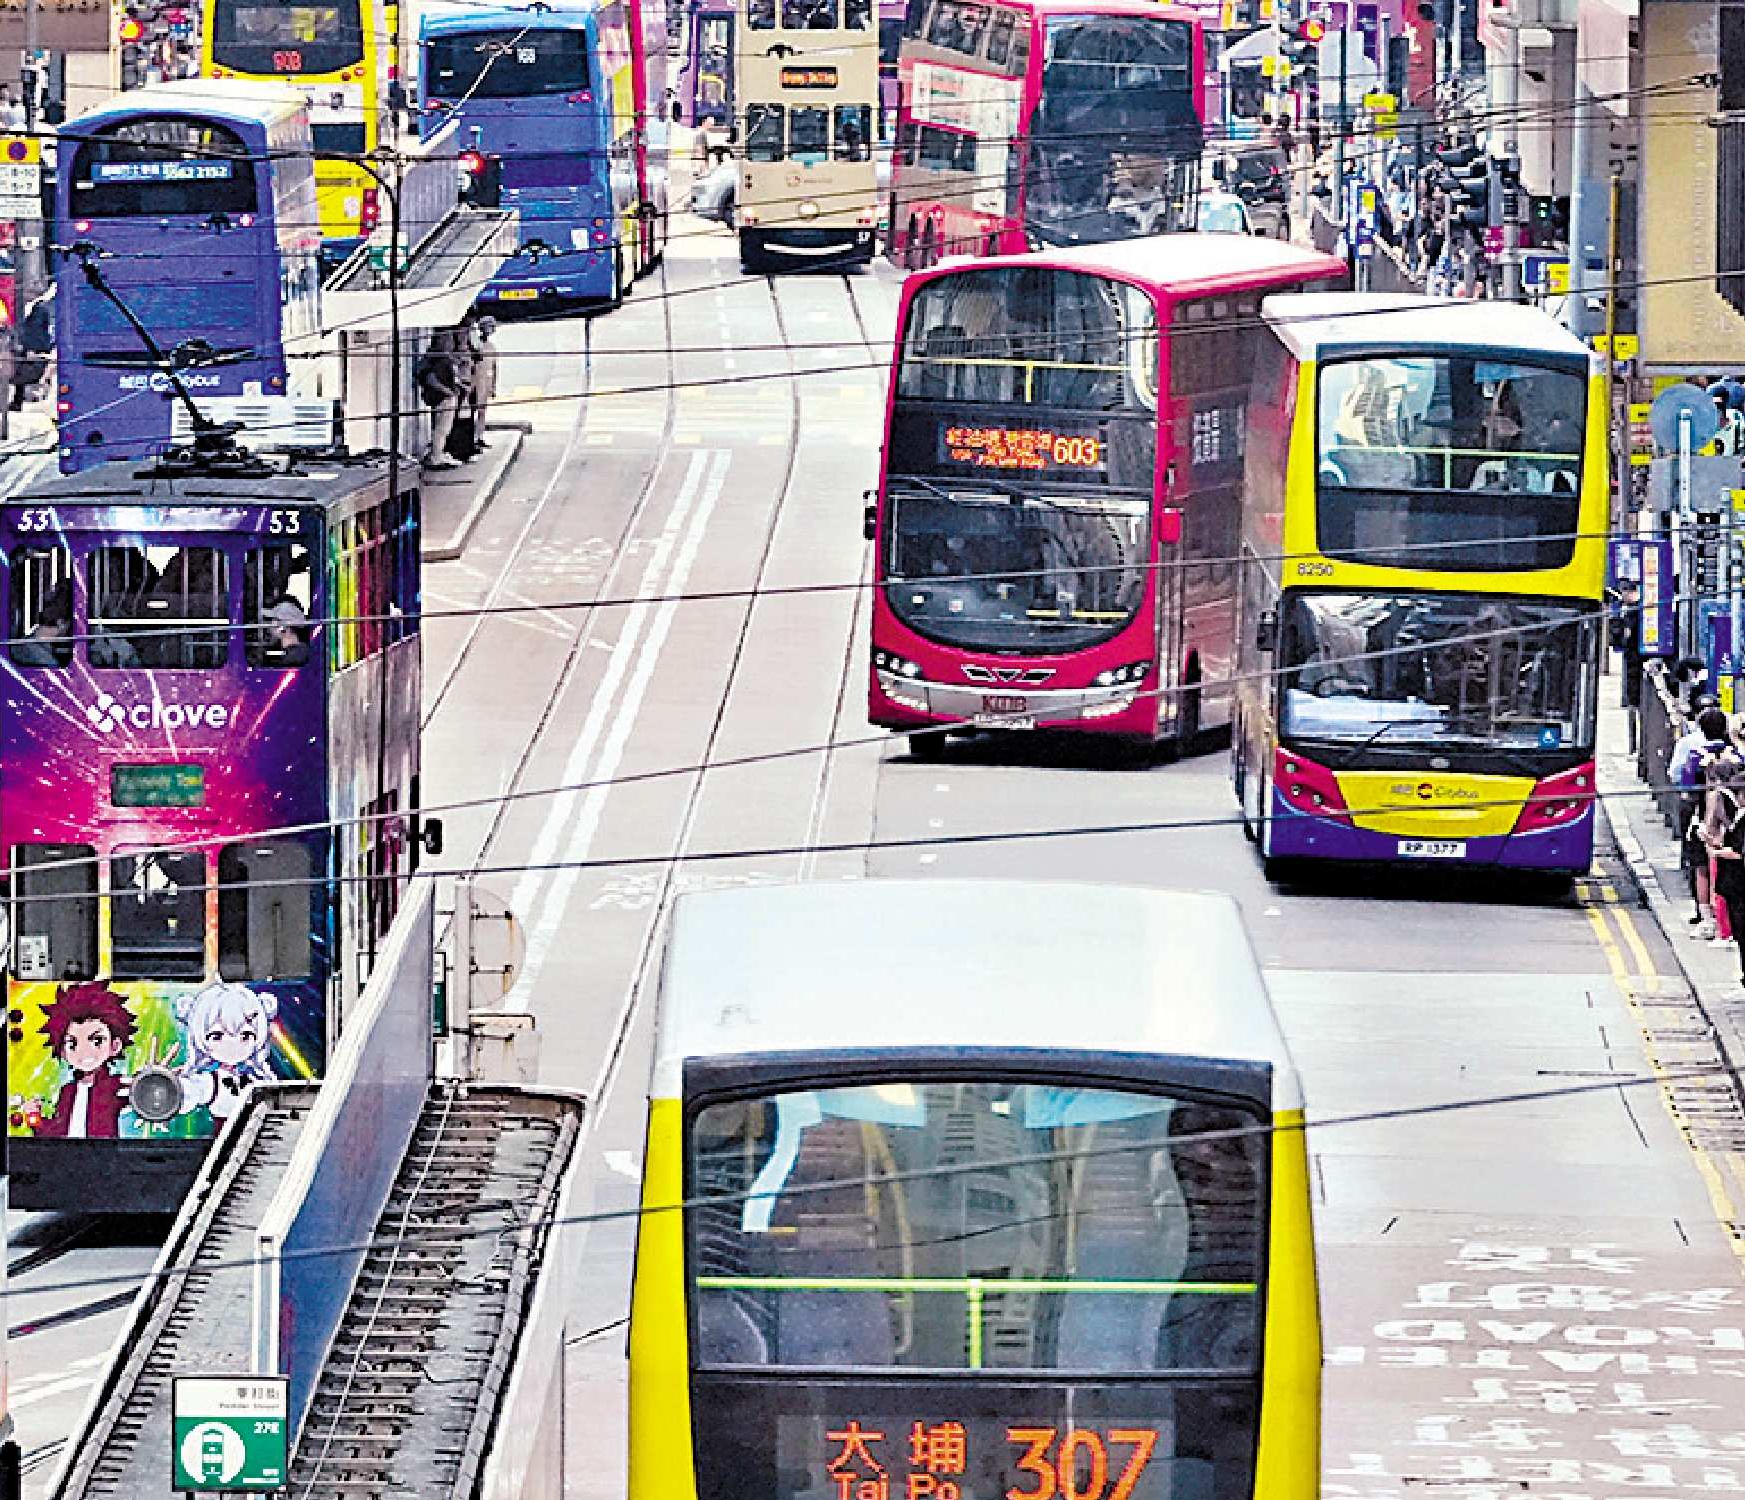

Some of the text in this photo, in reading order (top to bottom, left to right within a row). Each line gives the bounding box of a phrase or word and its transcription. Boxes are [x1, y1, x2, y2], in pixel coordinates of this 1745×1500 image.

[1054, 437, 1099, 466] 603
[18, 509, 50, 532] 53
[269, 510, 301, 534] 53
[131, 700, 229, 733] clove
[825, 1419, 968, 1476] 大埔
